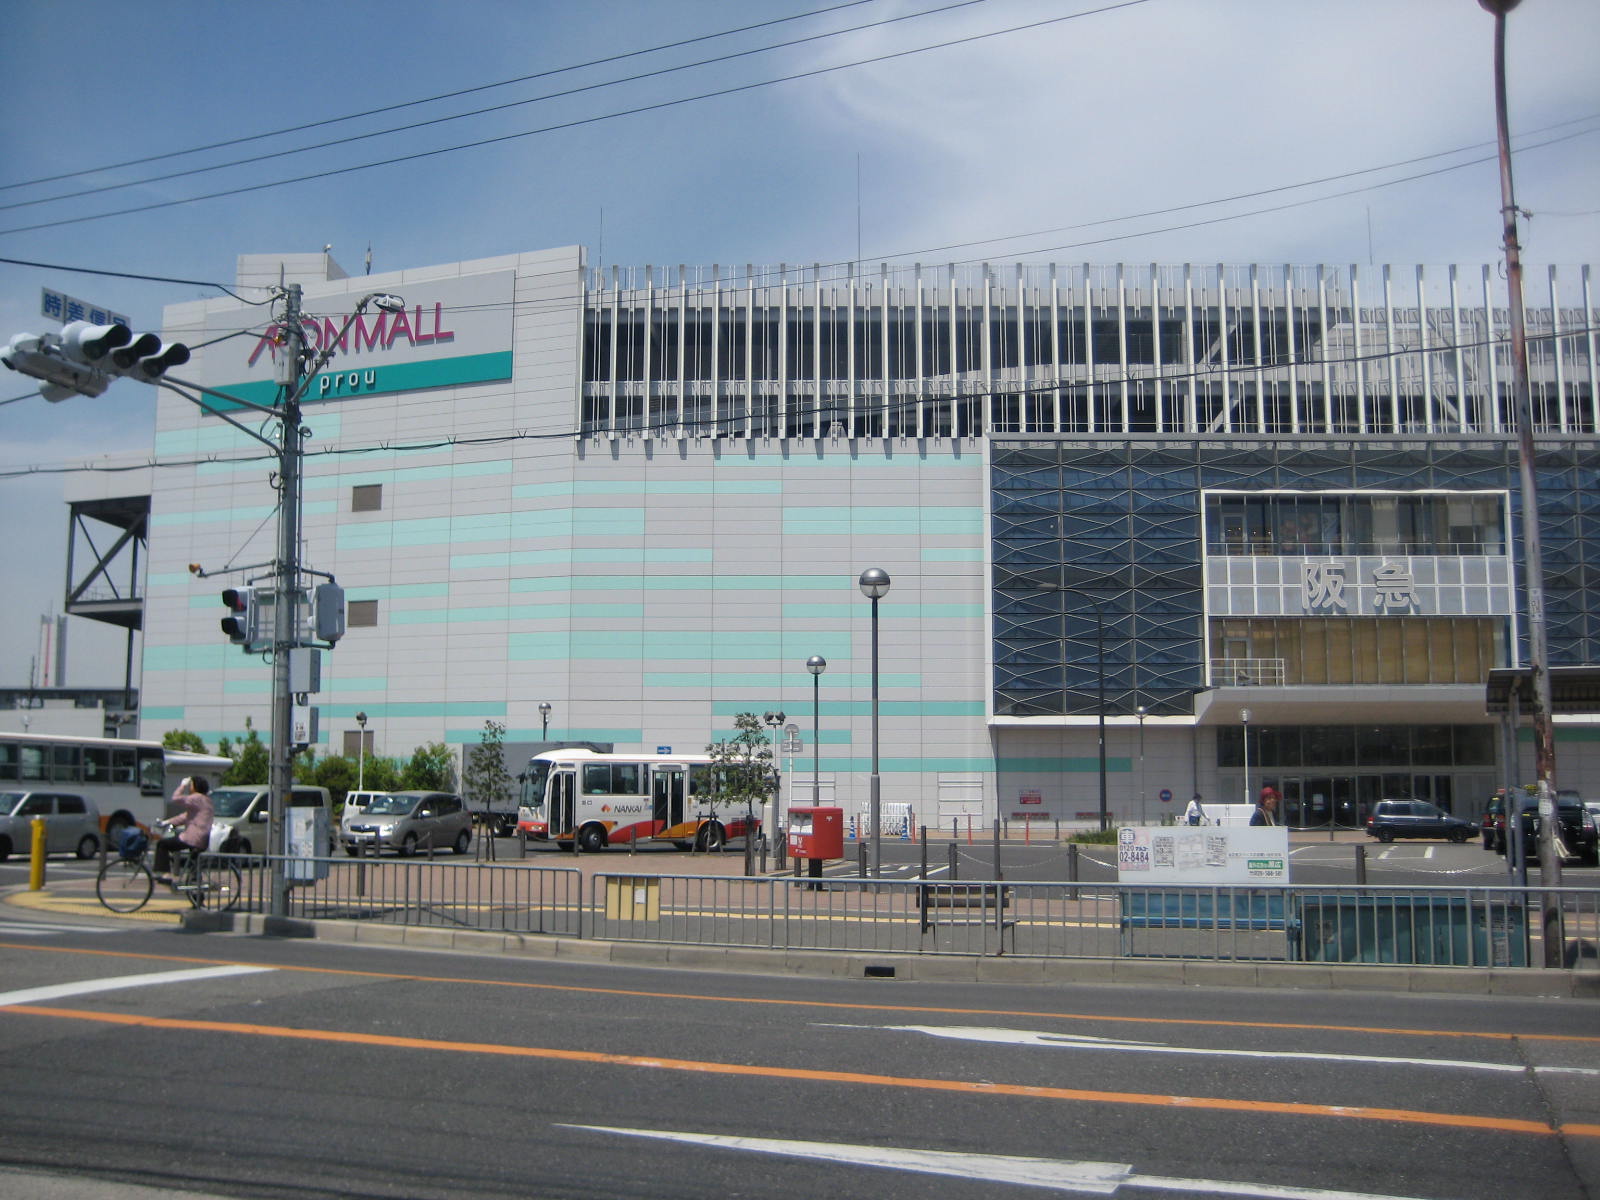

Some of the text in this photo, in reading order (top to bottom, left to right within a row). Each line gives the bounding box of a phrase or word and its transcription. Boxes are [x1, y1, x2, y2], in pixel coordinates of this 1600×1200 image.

[354, 301, 454, 351] MALL
[319, 368, 376, 395] prou
[1300, 561, 1421, 610] 阪急
[613, 804, 642, 814] NANKAI
[1119, 851, 1149, 862] 02-8484
